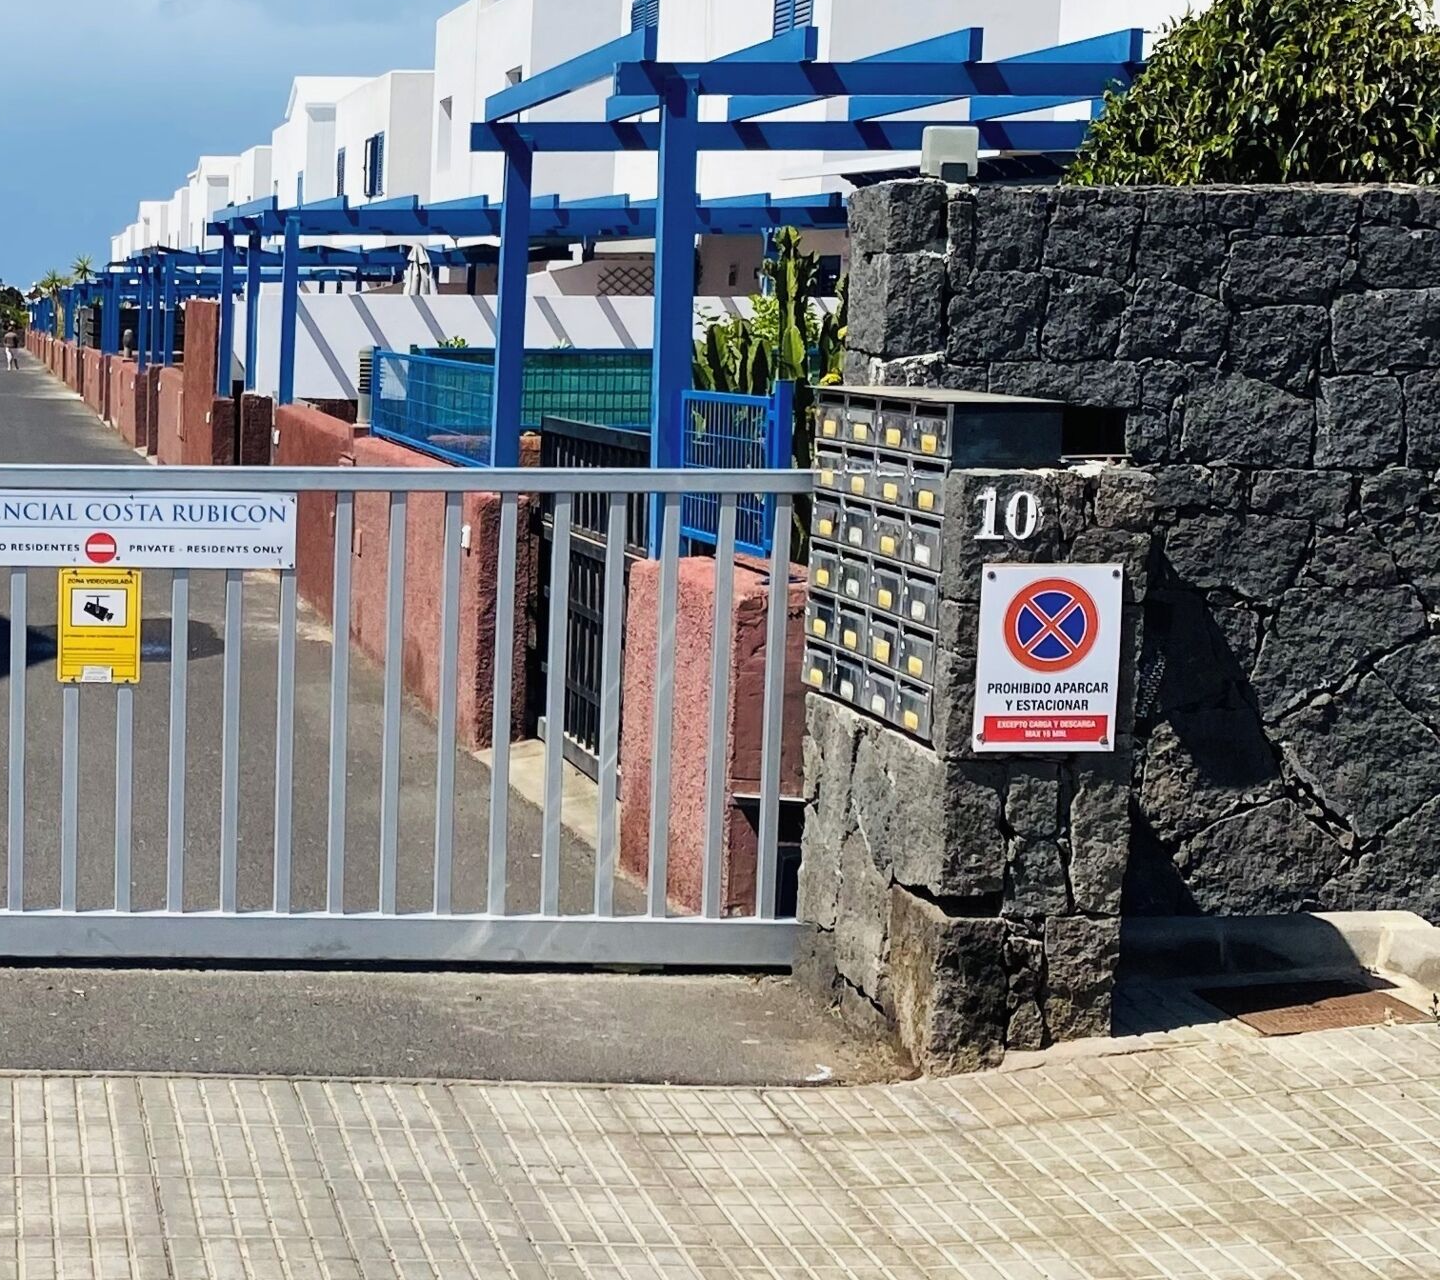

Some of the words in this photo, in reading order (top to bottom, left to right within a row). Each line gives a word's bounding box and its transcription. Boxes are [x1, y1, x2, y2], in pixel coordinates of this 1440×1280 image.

[85, 503, 164, 522] COSTA
[172, 504, 286, 523] RUBICON
[974, 487, 1037, 540] 10
[11, 543, 80, 552] RESIDENTES
[129, 545, 175, 553] PRIVATE
[187, 545, 249, 554] RESIDENTS
[253, 545, 284, 554] ONLY
[987, 682, 1051, 694] PROHIBIDO
[1054, 682, 1109, 694] APARCAR
[1005, 699, 1013, 711] Y
[1016, 699, 1089, 711] ESTACIONAR
[997, 720, 1028, 729] EXCEPTO
[1029, 720, 1053, 728] CARGA
[1054, 720, 1059, 728] Y
[1060, 720, 1096, 728] DESCARGA
